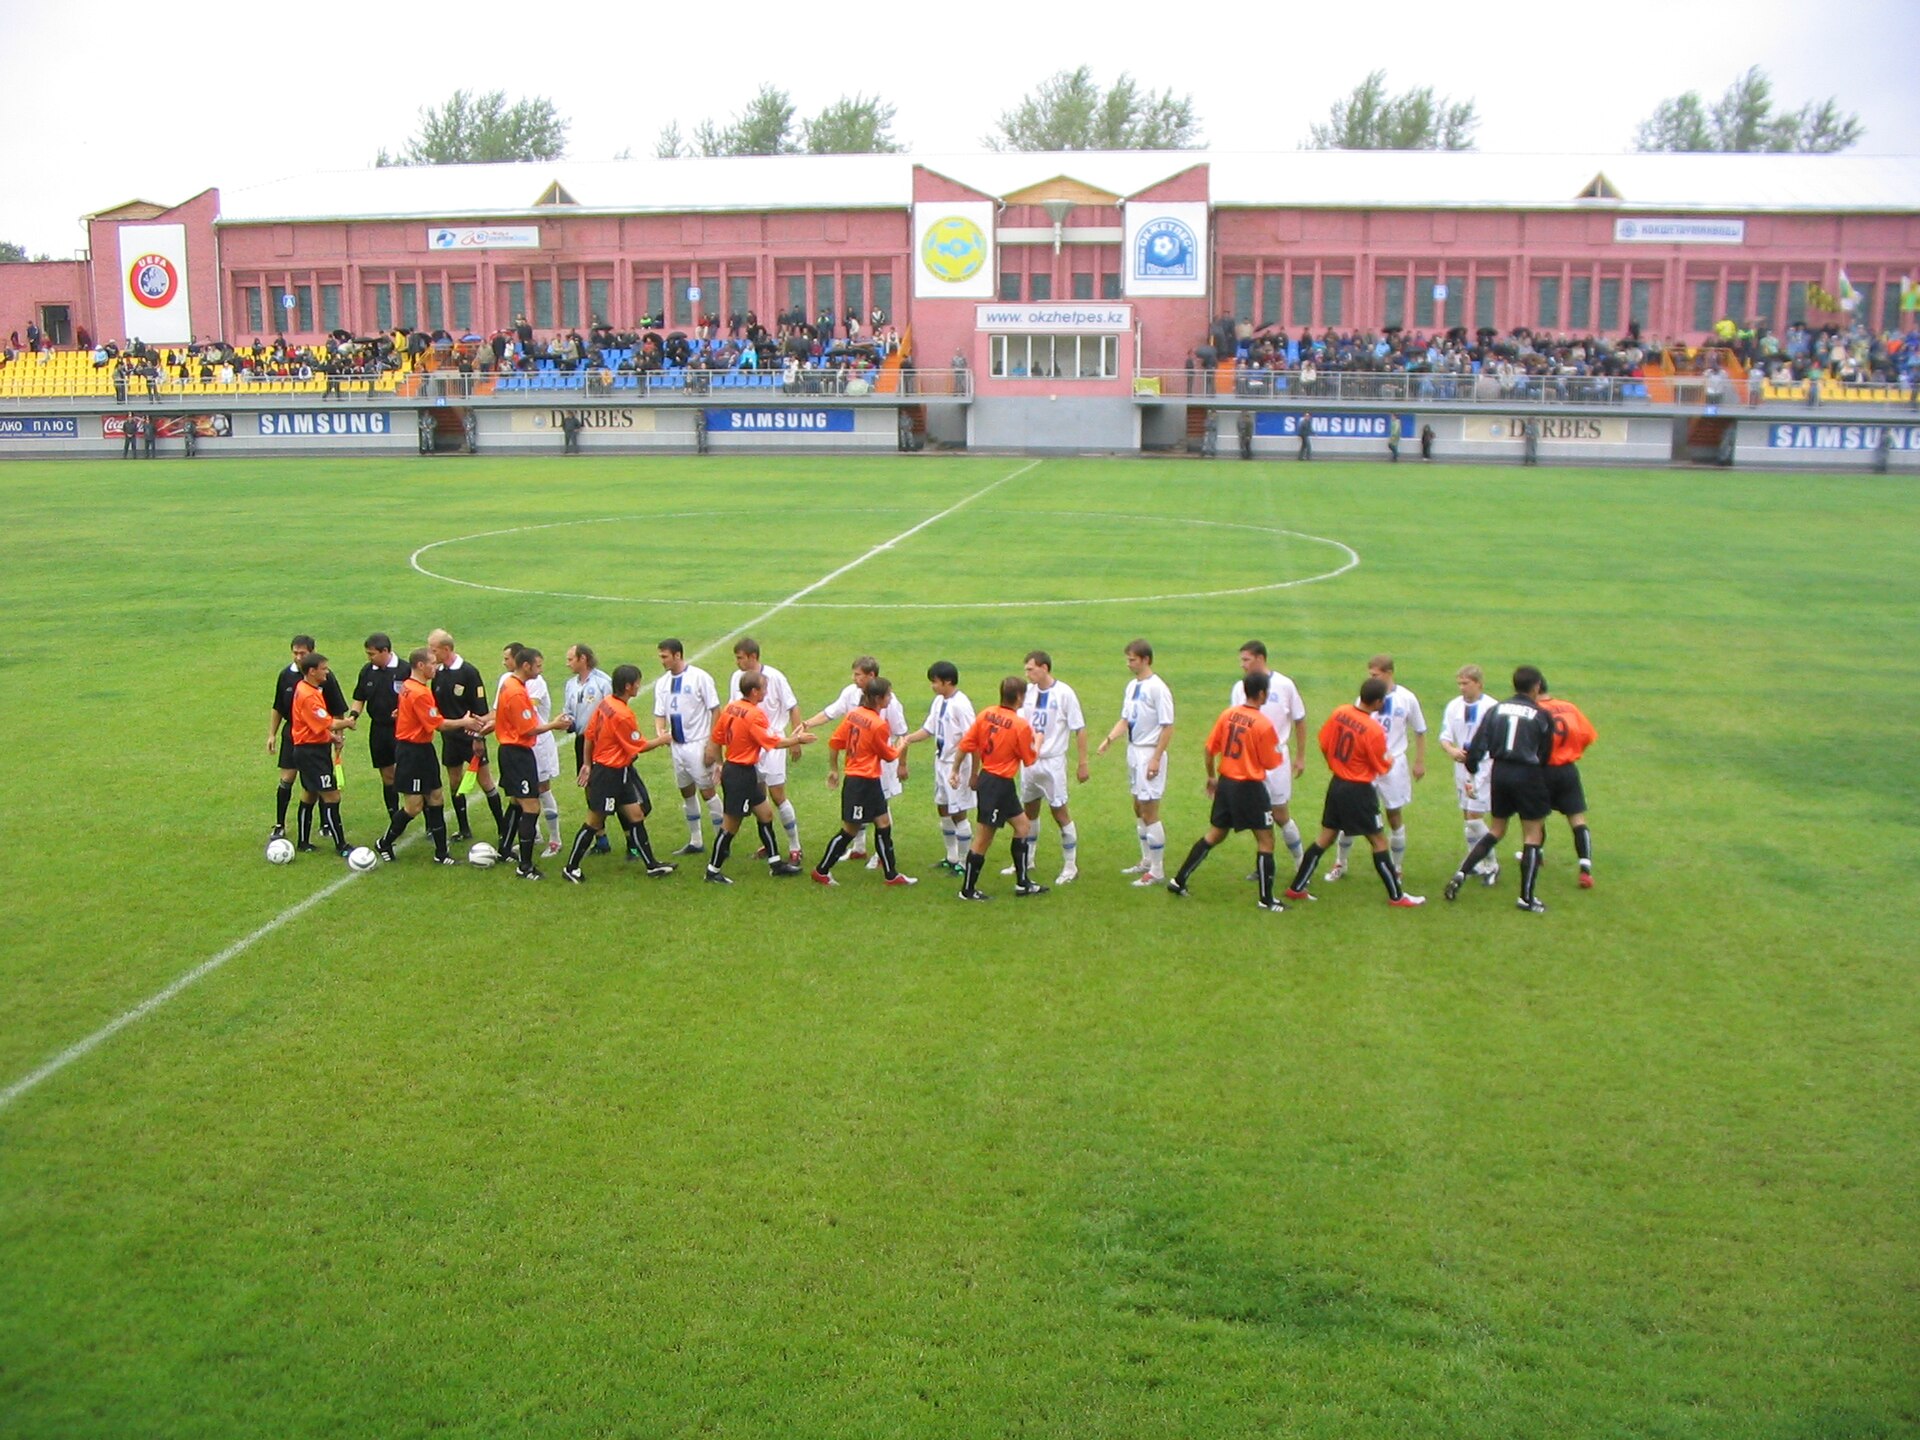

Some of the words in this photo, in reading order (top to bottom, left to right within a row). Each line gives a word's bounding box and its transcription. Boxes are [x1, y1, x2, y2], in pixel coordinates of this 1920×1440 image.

[138, 256, 167, 267] UEFA
[987, 312, 1022, 322] www.
[1029, 311, 1124, 325] okzhetpes.kz
[261, 413, 384, 434] SAMSUNG
[551, 409, 633, 428] DRBES
[731, 412, 827, 428] SAMSUNG
[1284, 416, 1386, 433] SMSUNG
[33, 421, 74, 431] ПЛЮС
[1509, 418, 1601, 439] DRBES
[1032, 712, 1048, 727] 20
[984, 725, 998, 755] 5
[1507, 716, 1519, 751] 1
[1225, 723, 1246, 760] 15
[1335, 725, 1356, 763] 10
[320, 775, 332, 789] 12
[413, 779, 421, 792] 11
[521, 780, 529, 794] 3
[604, 797, 615, 811] 18
[743, 799, 750, 813] 6
[853, 806, 864, 820] 13
[992, 809, 999, 822] 5
